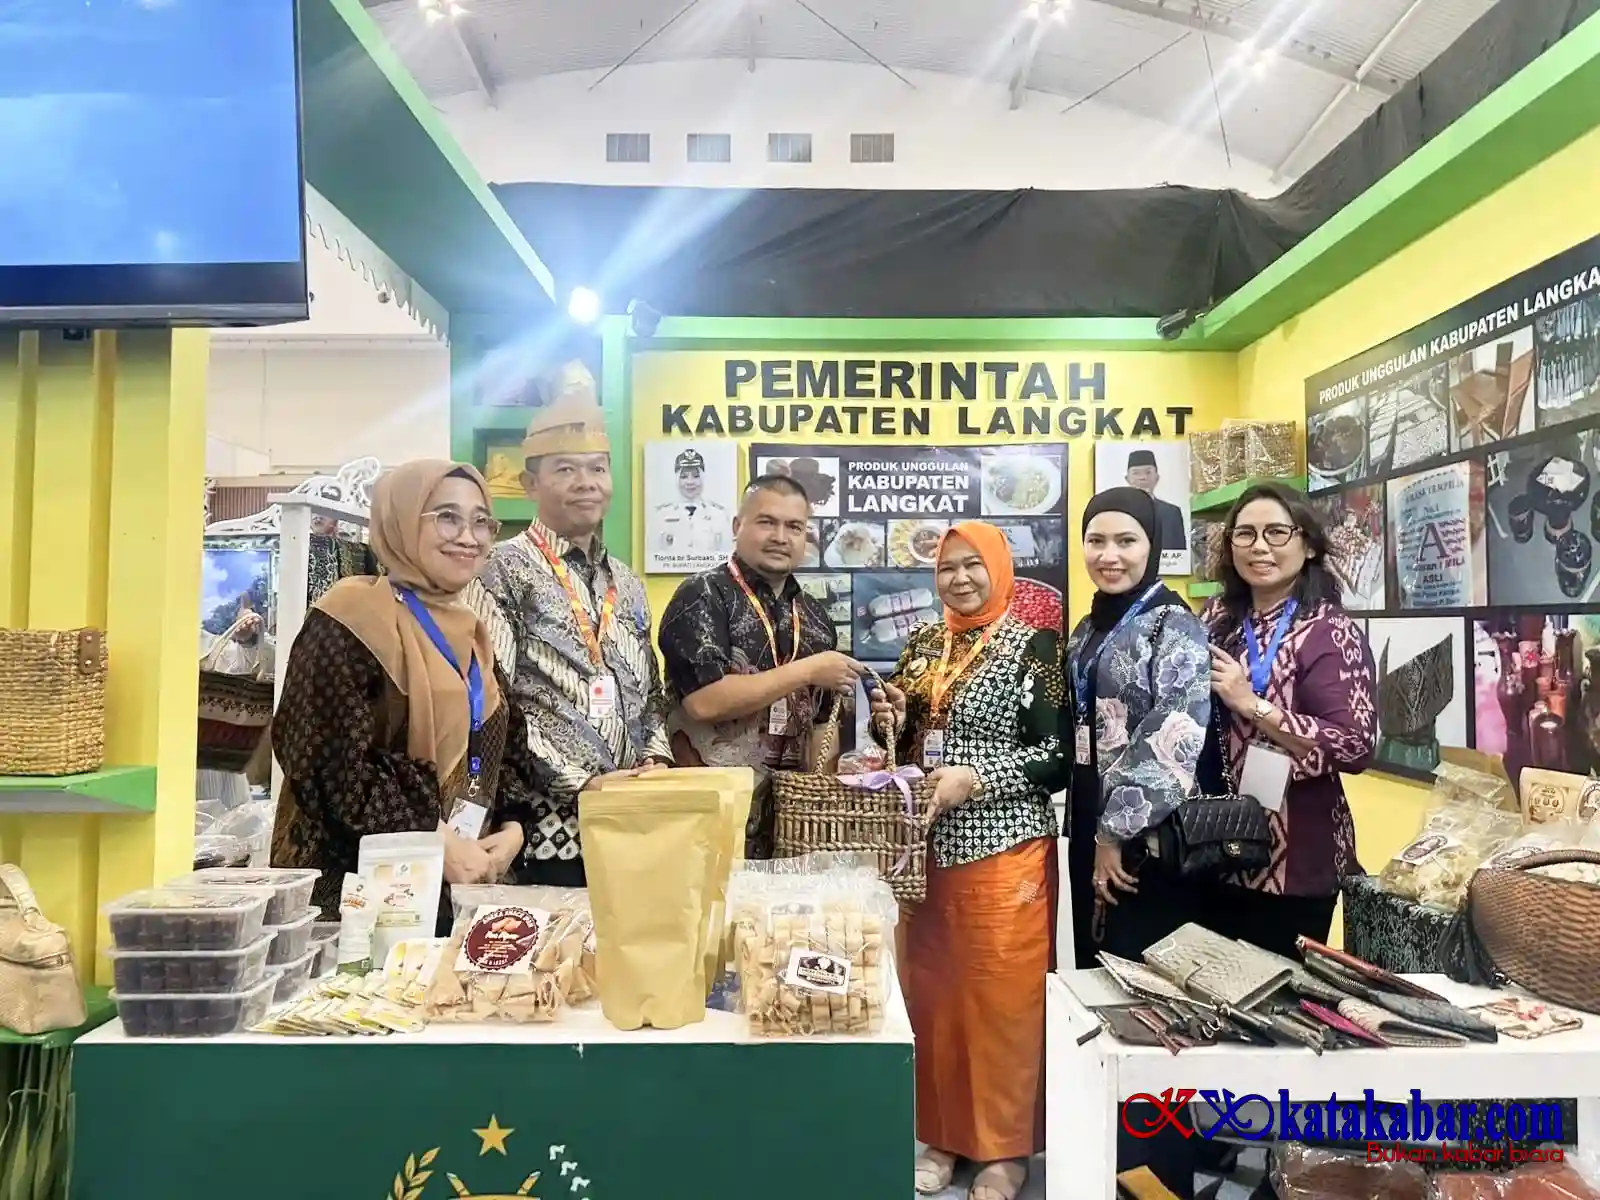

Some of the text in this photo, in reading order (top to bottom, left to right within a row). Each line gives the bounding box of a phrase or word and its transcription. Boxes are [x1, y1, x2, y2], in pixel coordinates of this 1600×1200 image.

[1319, 265, 1600, 405] PRODUK UNGGULAN KABUPATEN LANGKA
[725, 359, 1106, 401] PEMERINTAH
[662, 404, 1194, 436] KABUPATEN LANGKAT
[848, 461, 969, 472] PRODUK UNGGULAN
[848, 474, 970, 490] KABUPATEN
[848, 494, 970, 513] LANGKAT
